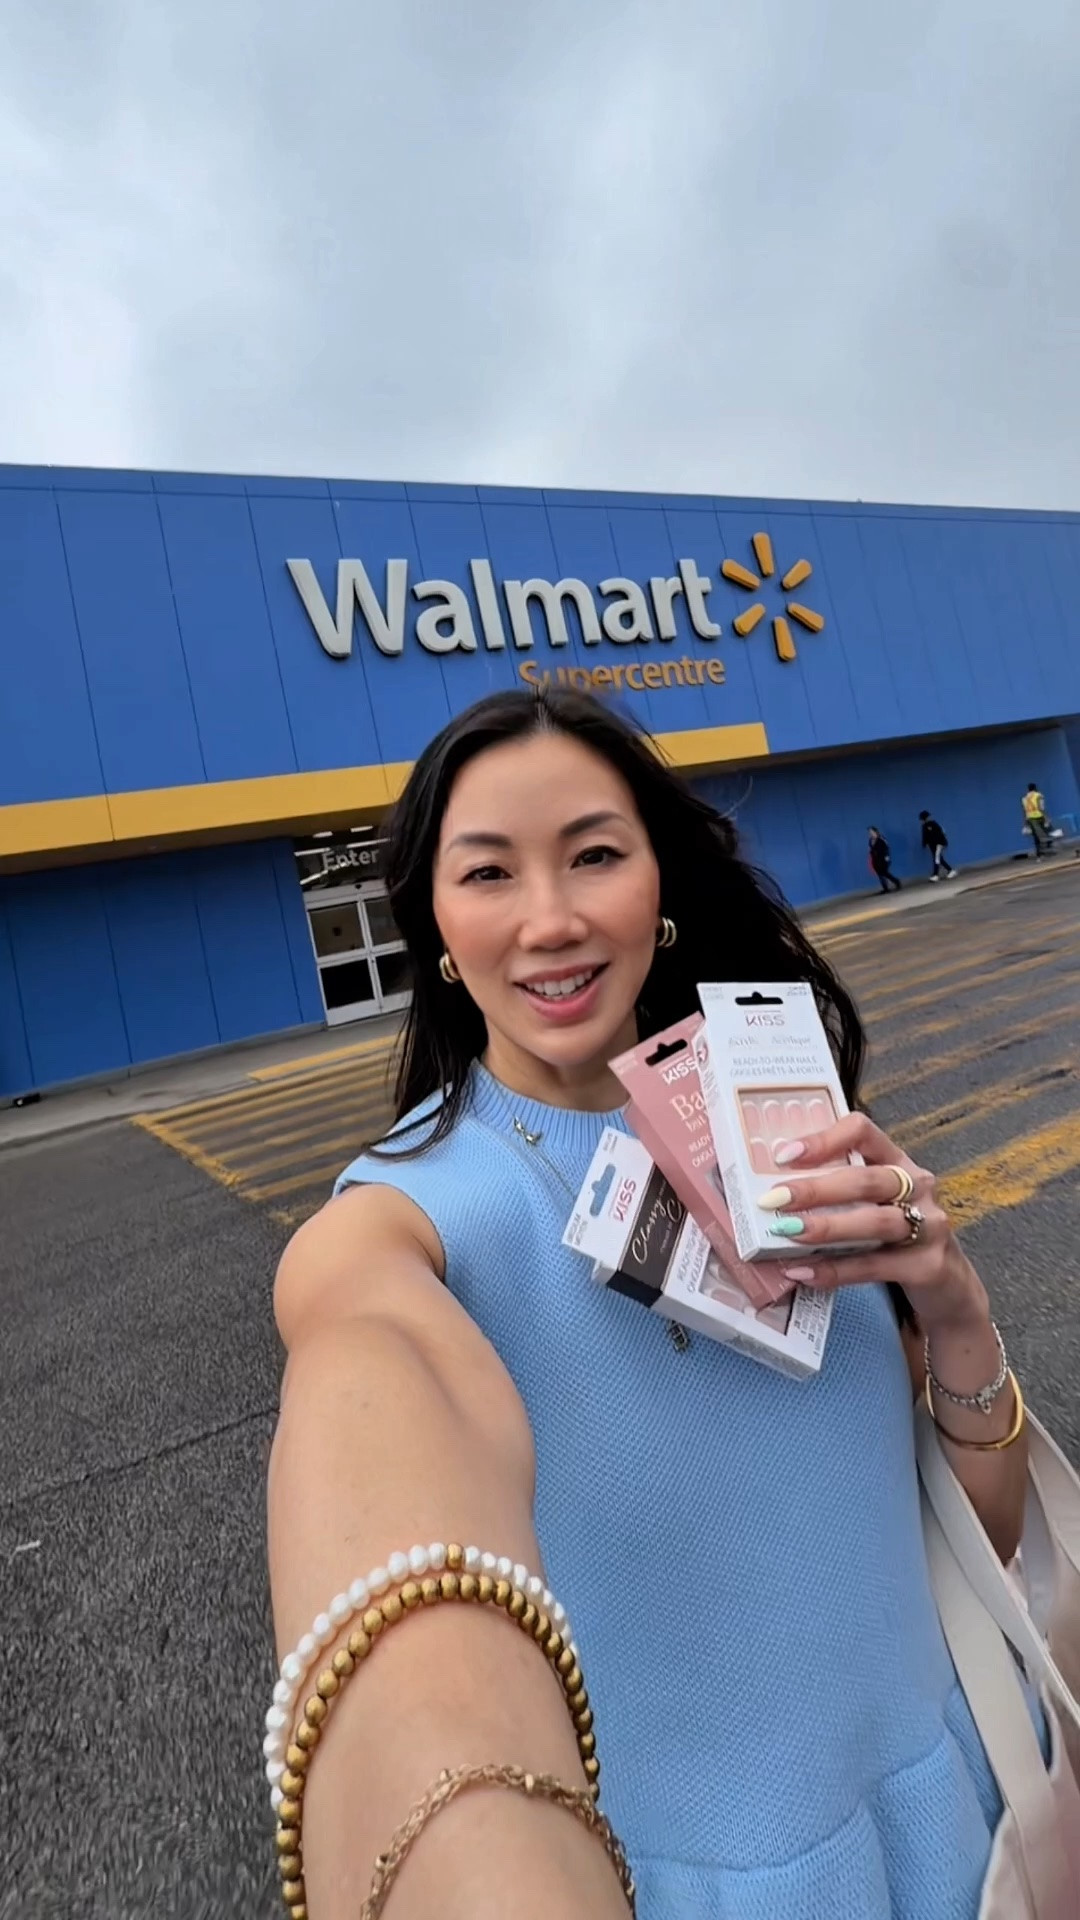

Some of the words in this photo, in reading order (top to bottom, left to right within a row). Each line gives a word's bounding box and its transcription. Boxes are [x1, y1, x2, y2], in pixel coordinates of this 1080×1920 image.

[286, 558, 722, 658] Walmart
[519, 655, 726, 691] Supercentre
[322, 849, 380, 872] Enter
[745, 1014, 785, 1027] KISS
[661, 1057, 698, 1086] KISS
[614, 1178, 637, 1222] KISS
[631, 1196, 667, 1265] Classy
